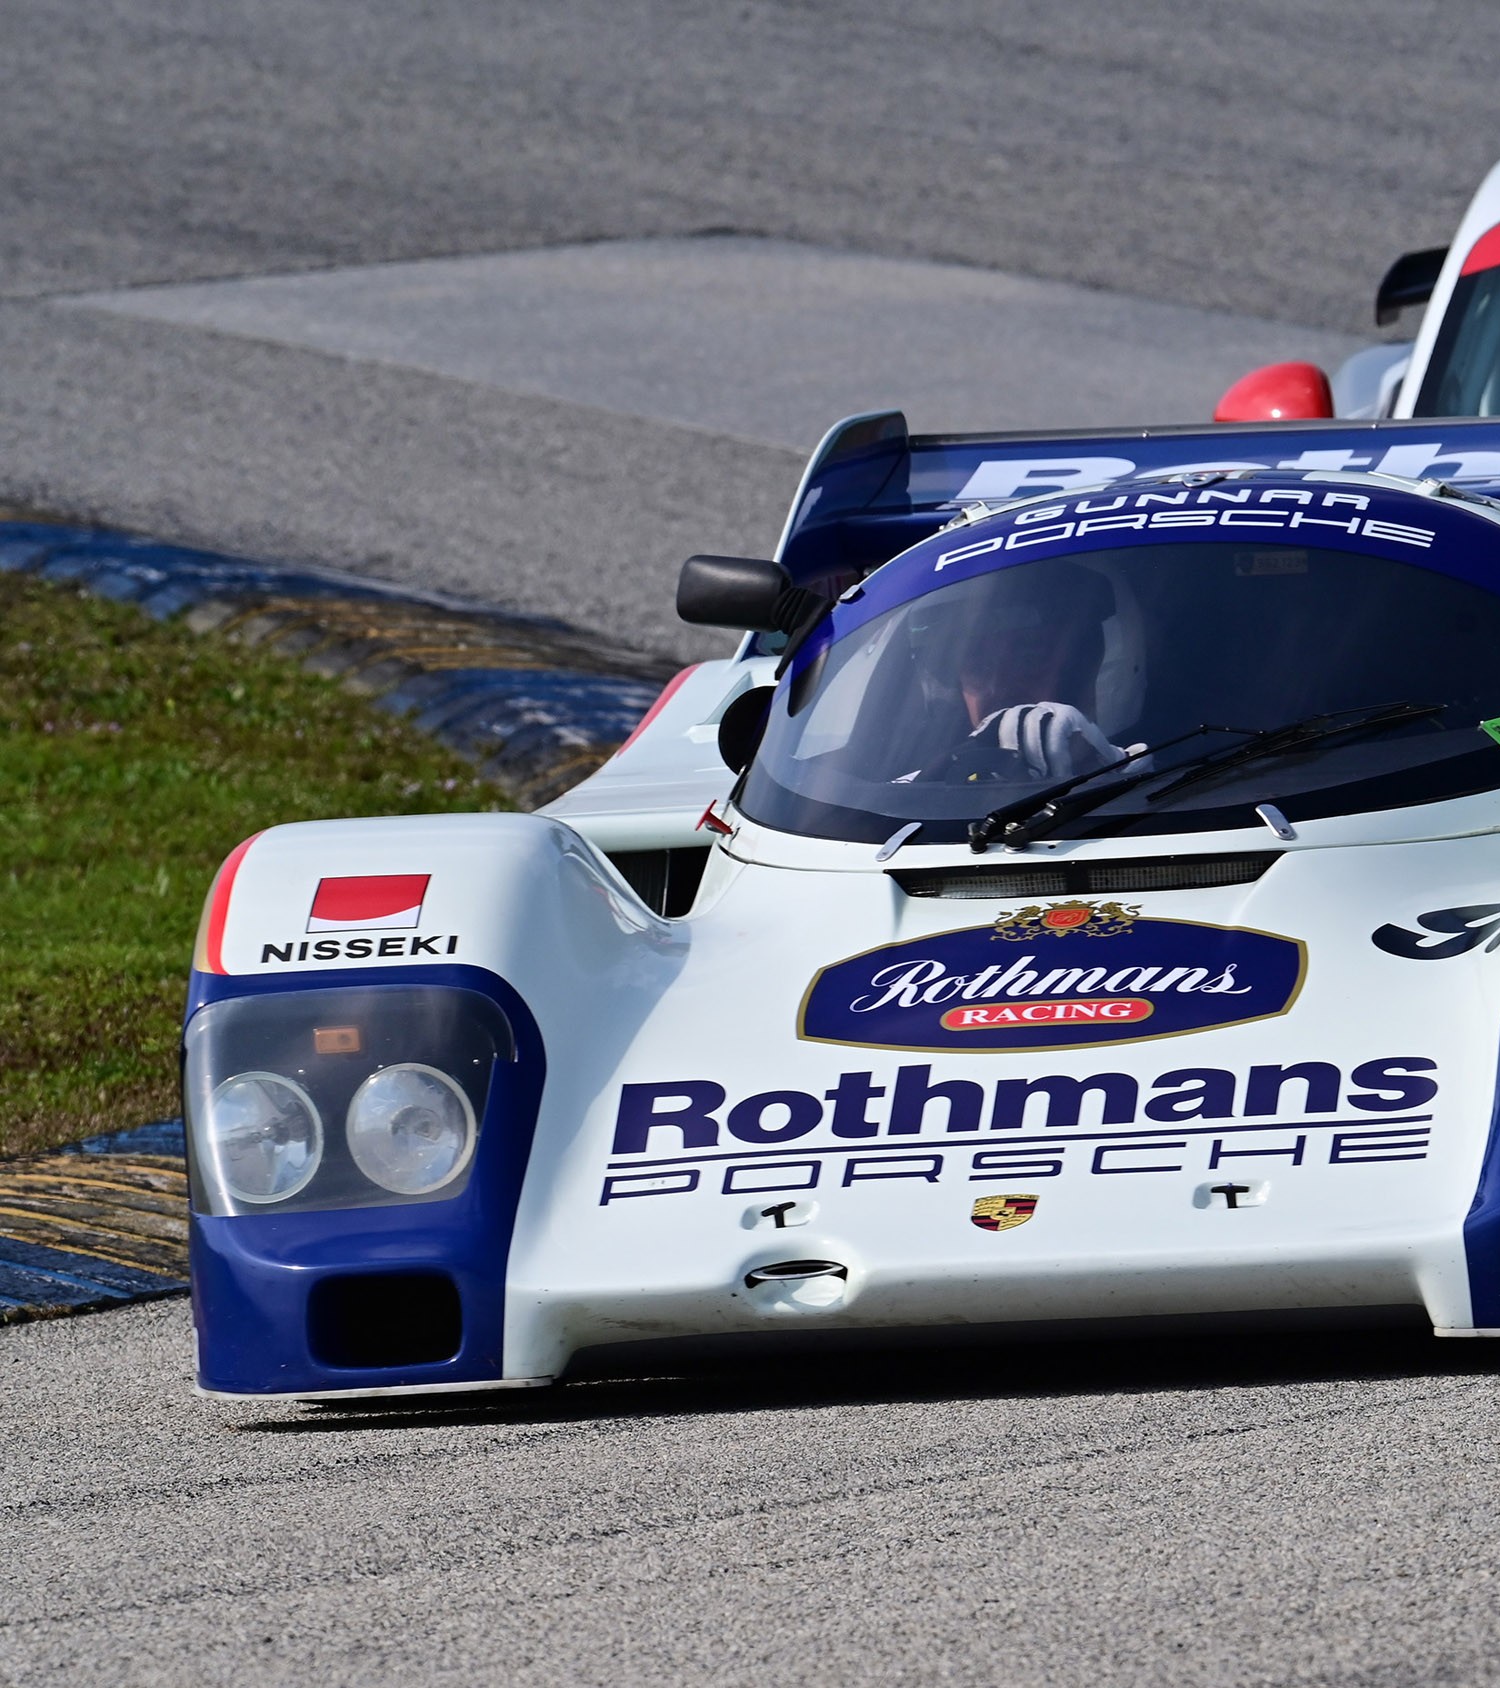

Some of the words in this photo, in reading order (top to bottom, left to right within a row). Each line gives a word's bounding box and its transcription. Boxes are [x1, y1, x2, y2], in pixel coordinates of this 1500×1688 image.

[1014, 488, 1371, 525] GUNNAR
[934, 509, 1435, 572] PORSCHE
[261, 935, 459, 963] NISSEKI
[851, 955, 1252, 1013] Rothmans
[959, 1001, 1134, 1026] RACING
[611, 1056, 1439, 1155] Rothmans
[599, 1128, 1431, 1206] PORSCHE
